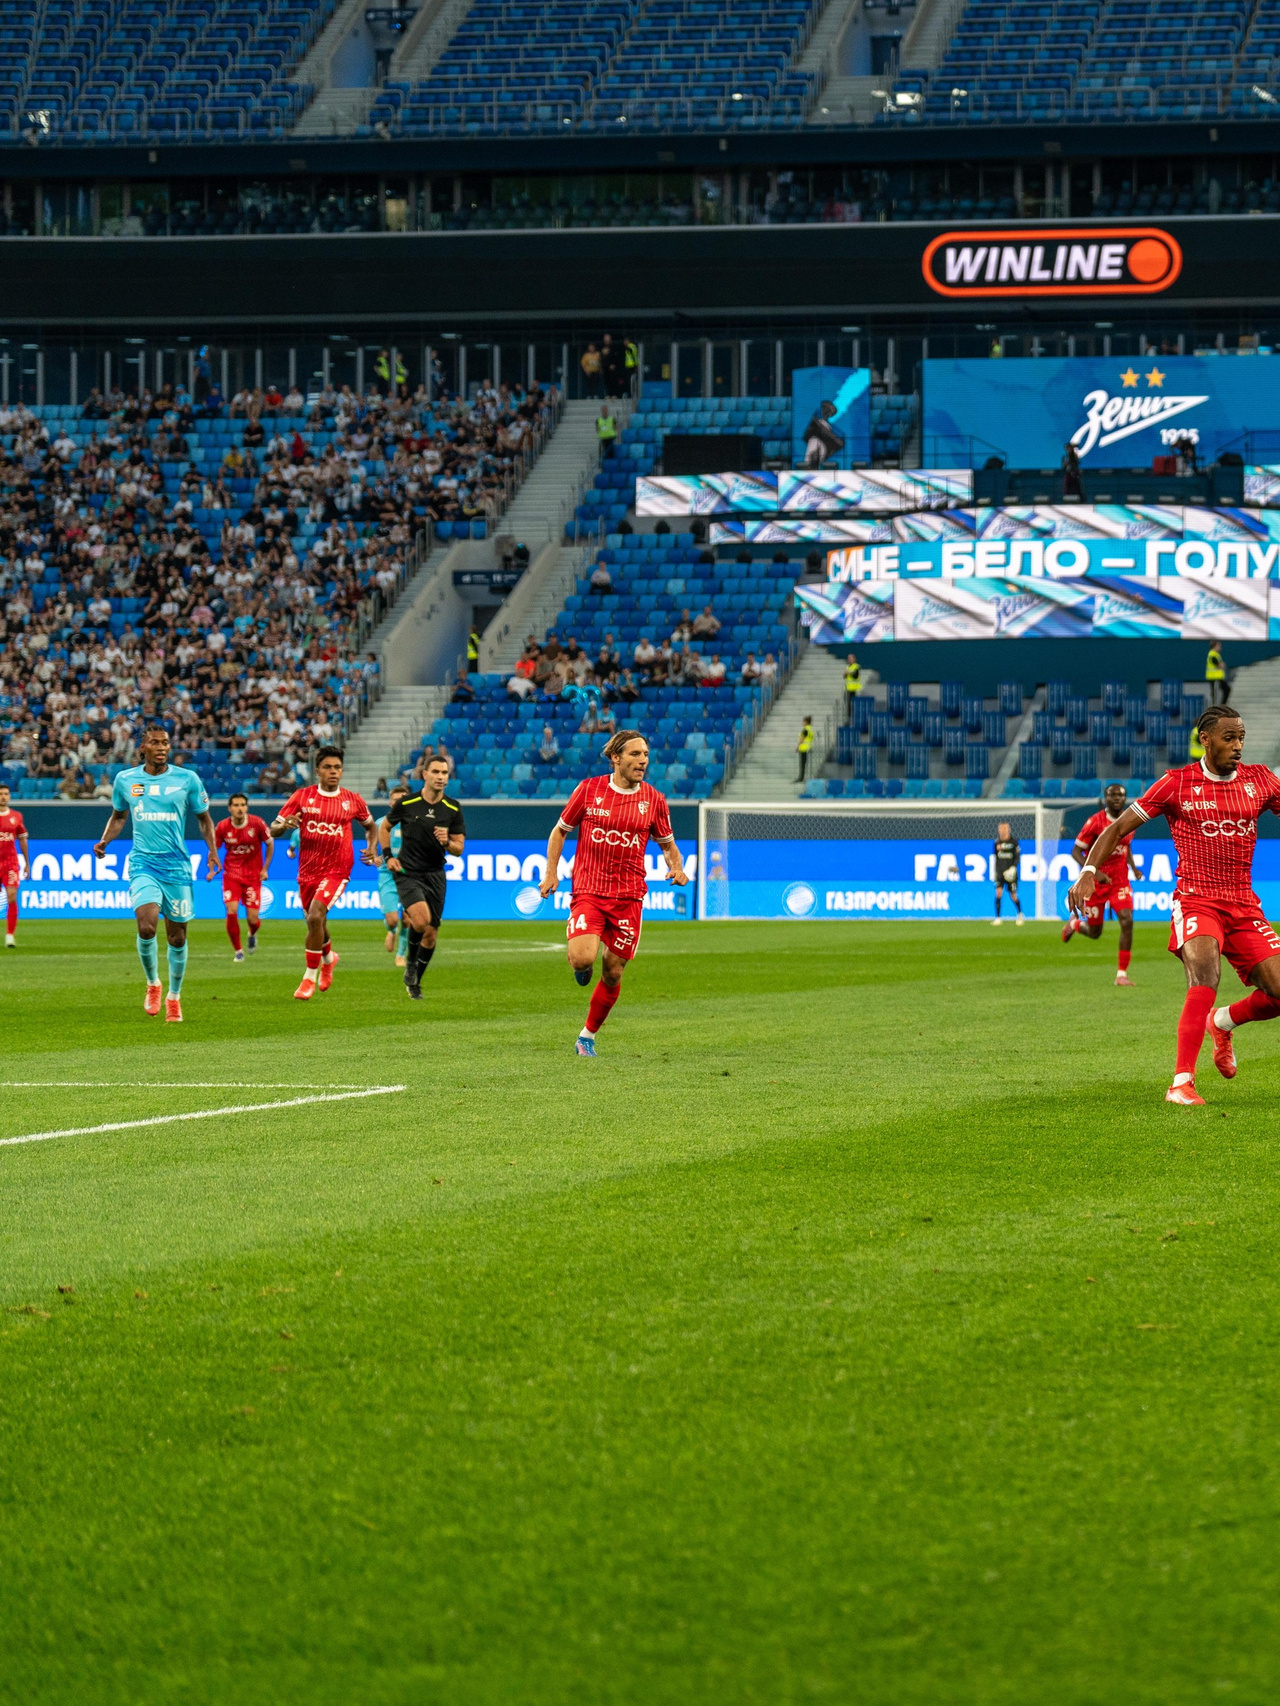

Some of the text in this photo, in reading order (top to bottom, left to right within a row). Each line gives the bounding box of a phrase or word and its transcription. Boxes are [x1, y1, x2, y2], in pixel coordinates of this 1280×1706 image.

[945, 244, 1126, 282] WINLINE
[828, 546, 900, 582] СИНЕ
[941, 539, 1090, 579] БЕЛО
[593, 807, 610, 817] UBS
[1195, 800, 1216, 810] UBS
[21, 890, 133, 909] ГАЗПРОМБАН
[171, 899, 188, 918] 30
[826, 891, 950, 910] ГАЗПРОМБАНК
[569, 914, 587, 934] 14
[1186, 916, 1199, 936] 5
